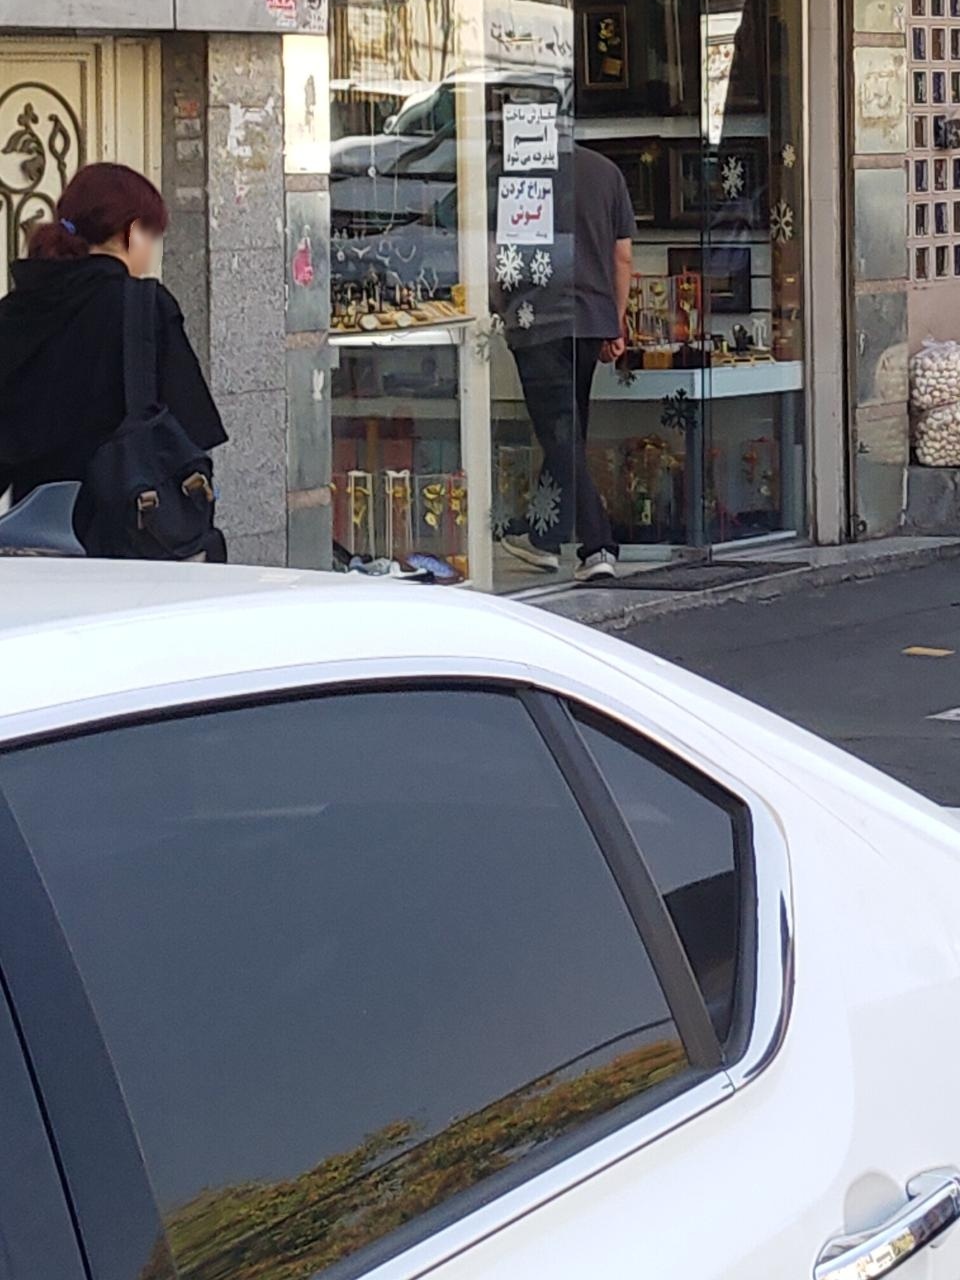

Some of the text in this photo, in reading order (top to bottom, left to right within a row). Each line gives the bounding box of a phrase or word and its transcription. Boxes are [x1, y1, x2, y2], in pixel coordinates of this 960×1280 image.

[513, 125, 548, 150] اسم
[500, 179, 551, 201] سوراخ کردن
[511, 204, 542, 227] گوش
